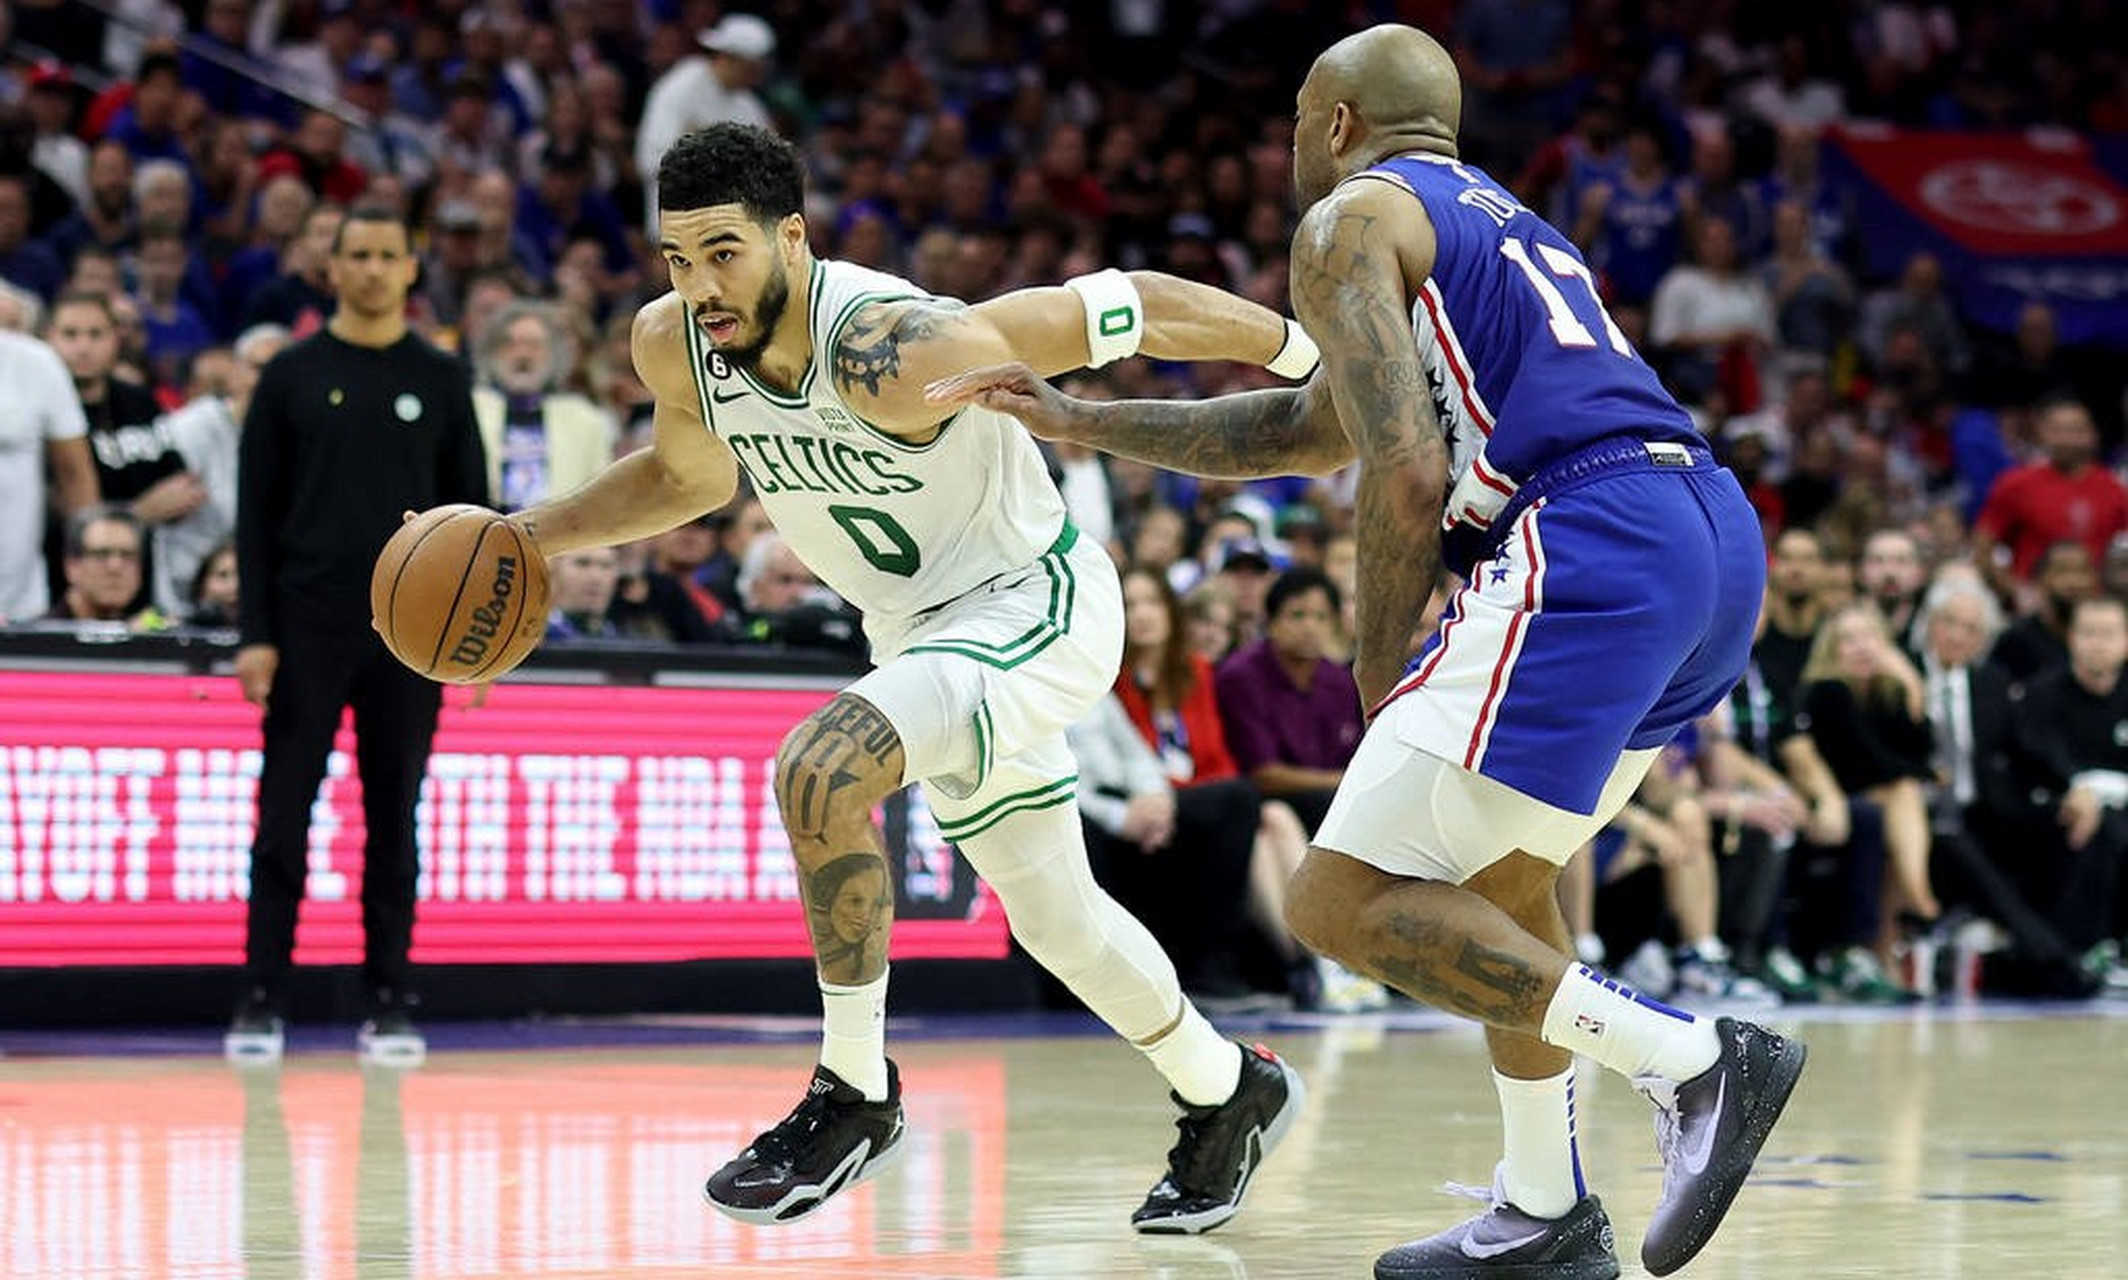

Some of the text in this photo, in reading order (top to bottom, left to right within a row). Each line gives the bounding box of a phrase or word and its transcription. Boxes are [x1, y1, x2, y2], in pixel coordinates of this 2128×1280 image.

[1099, 305, 1135, 337] 0
[1499, 236, 1633, 359] 17
[728, 433, 925, 496] CELTICS
[828, 504, 922, 578] 0
[450, 556, 516, 666] Wilson
[517, 753, 630, 902] THE
